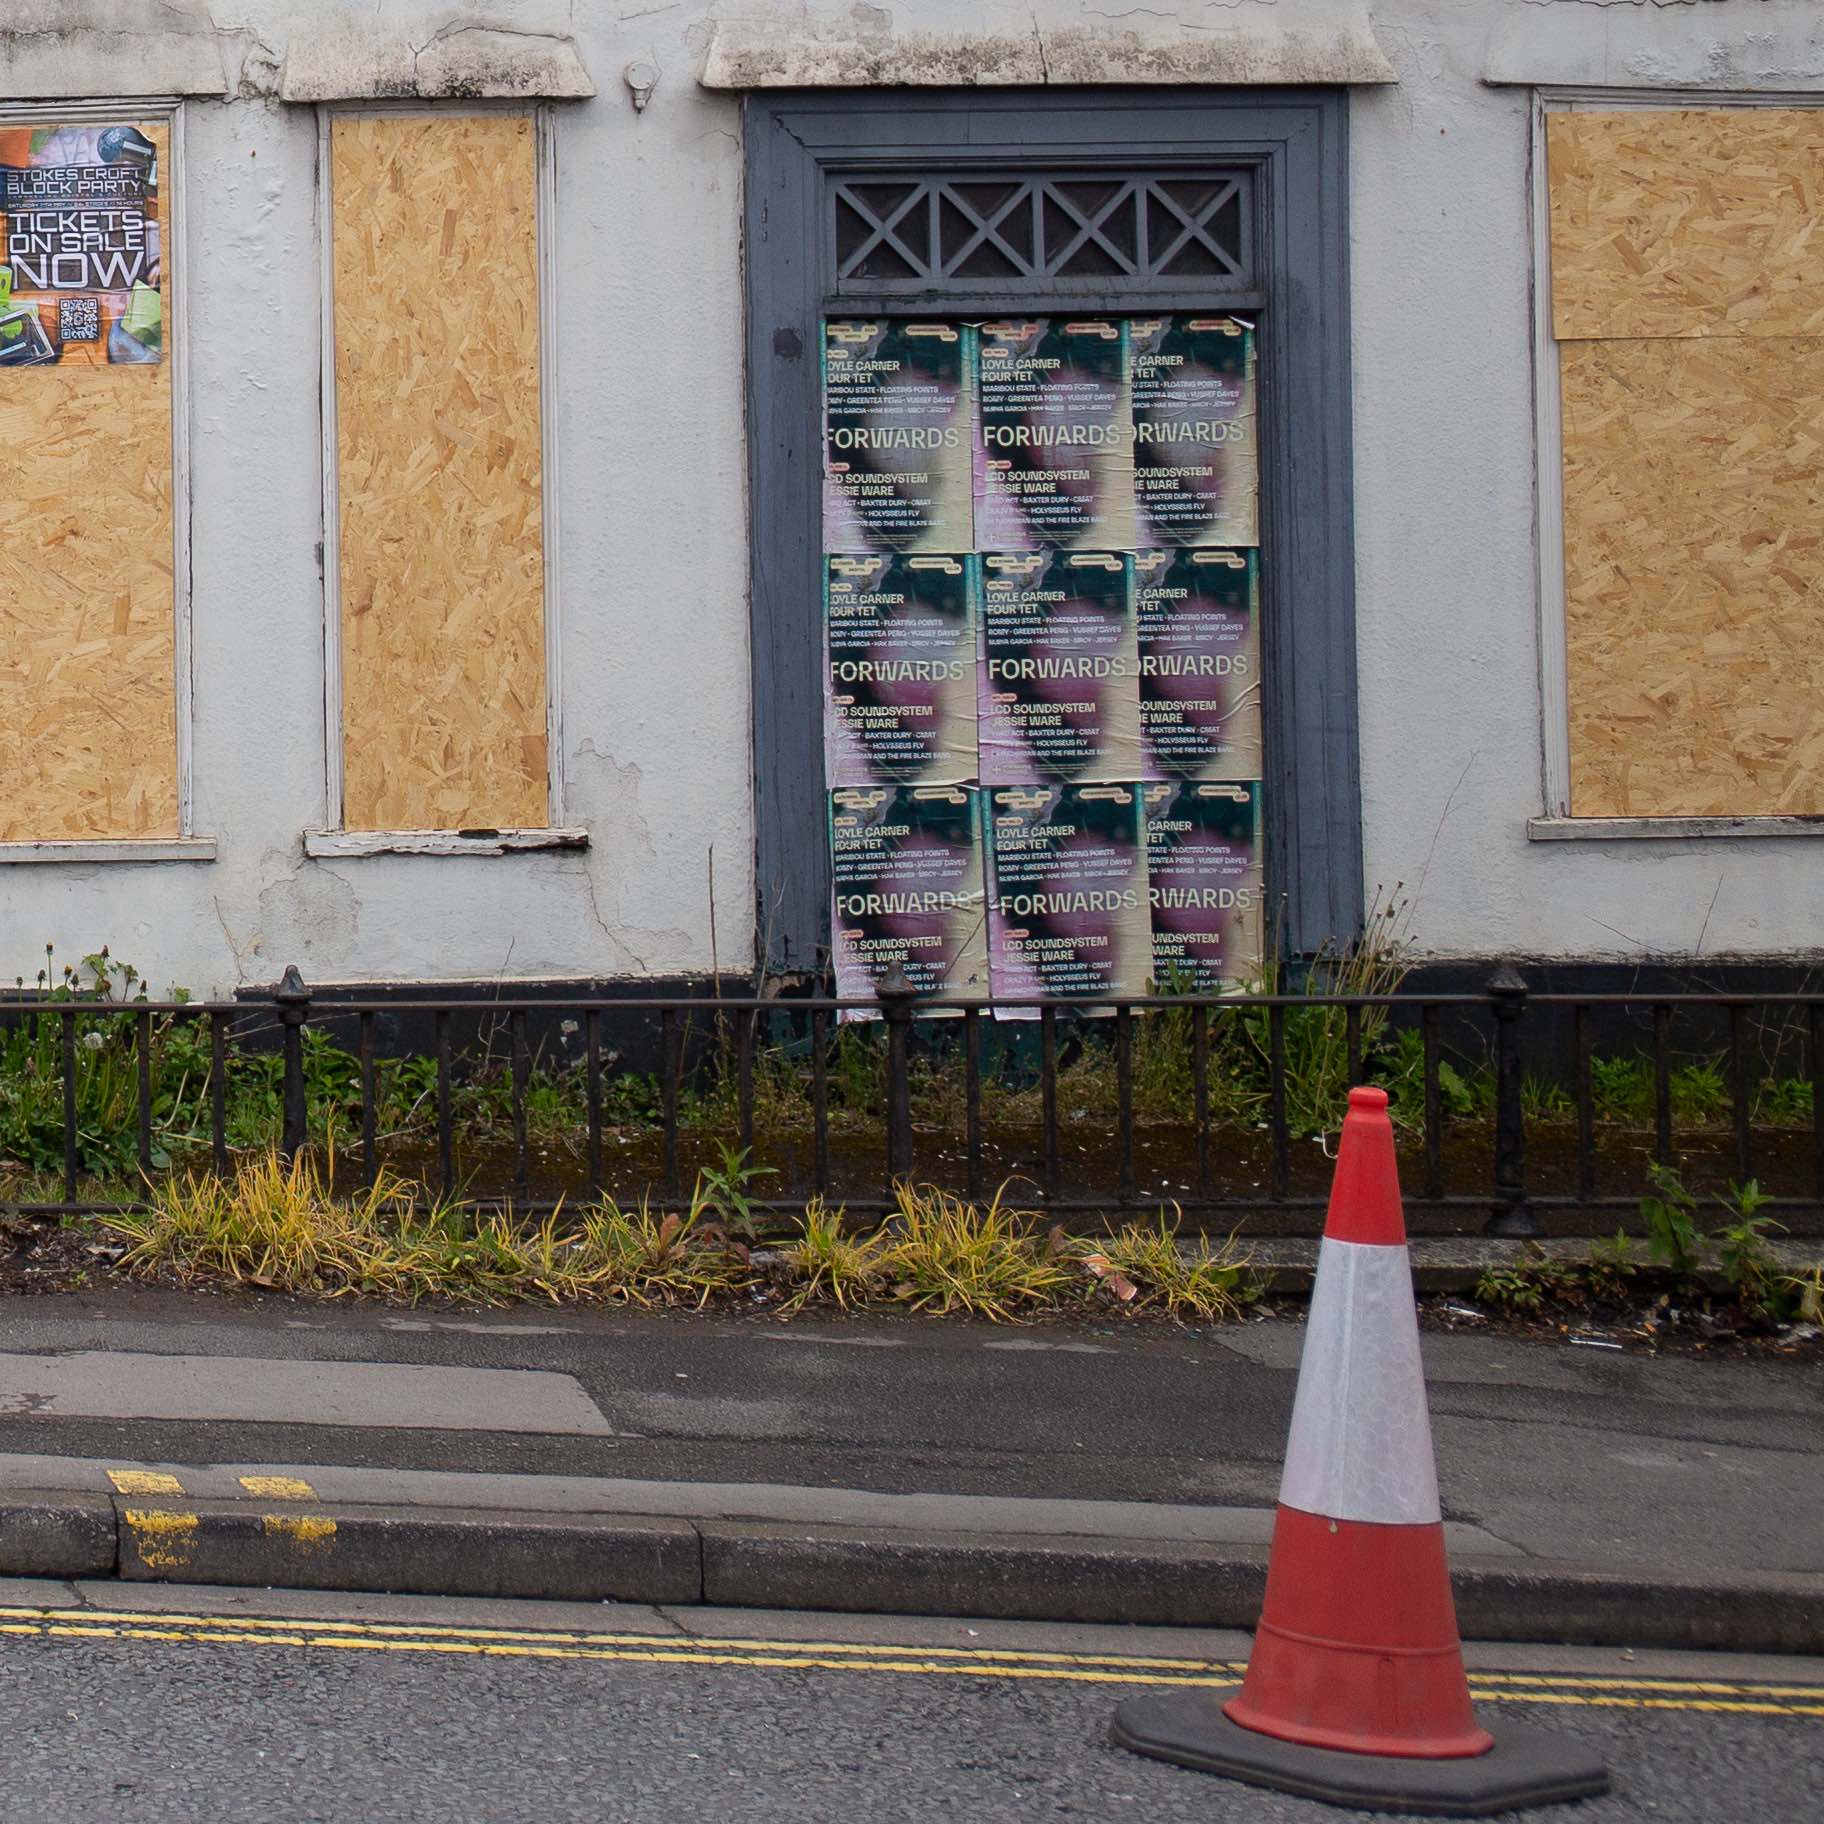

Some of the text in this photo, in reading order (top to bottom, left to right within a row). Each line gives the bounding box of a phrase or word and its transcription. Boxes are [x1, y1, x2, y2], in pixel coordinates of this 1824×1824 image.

[8, 169, 78, 182] STOKES
[8, 180, 140, 195] BLOCK PARTY
[9, 211, 143, 233] TICKETS
[10, 231, 144, 253] ON SALE
[11, 252, 144, 289] NOW
[856, 361, 900, 370] CARNER
[982, 359, 1060, 369] LOYLE CARNER
[853, 374, 872, 383] TET
[982, 371, 1032, 381] FOUR TET
[983, 425, 1120, 446] FORWARDS
[846, 473, 928, 483] SOUNDSYSTEM
[1008, 470, 1090, 480] SOUNDSYSTEM
[862, 486, 894, 495] WARE
[1024, 484, 1056, 493] WARE
[860, 594, 904, 604] CARNER
[987, 592, 1066, 602] LOYLE CARNER
[858, 606, 876, 616] TET
[987, 604, 1038, 614] FOUR TET
[831, 661, 964, 681] FORWARDS
[989, 657, 1126, 679] FORWARDS
[850, 706, 932, 716] SOUNDSYSTEM
[1013, 703, 1096, 714] SOUNDSYSTEM
[866, 719, 899, 728] WARE
[1030, 716, 1062, 725] WARE
[865, 826, 910, 837] CARNER
[997, 826, 1075, 839] LOYLE CARNER
[863, 839, 882, 849] TET
[997, 839, 1048, 850] FOUR TET
[837, 890, 970, 917] FORWARDS
[1001, 889, 1137, 916] FORWARDS
[860, 936, 942, 950] SOUNDSYSTEM
[1003, 936, 1108, 951] LCD SOUNDSYSTEM
[876, 951, 909, 961] WARE
[1006, 951, 1075, 962] JESSIE WARE
